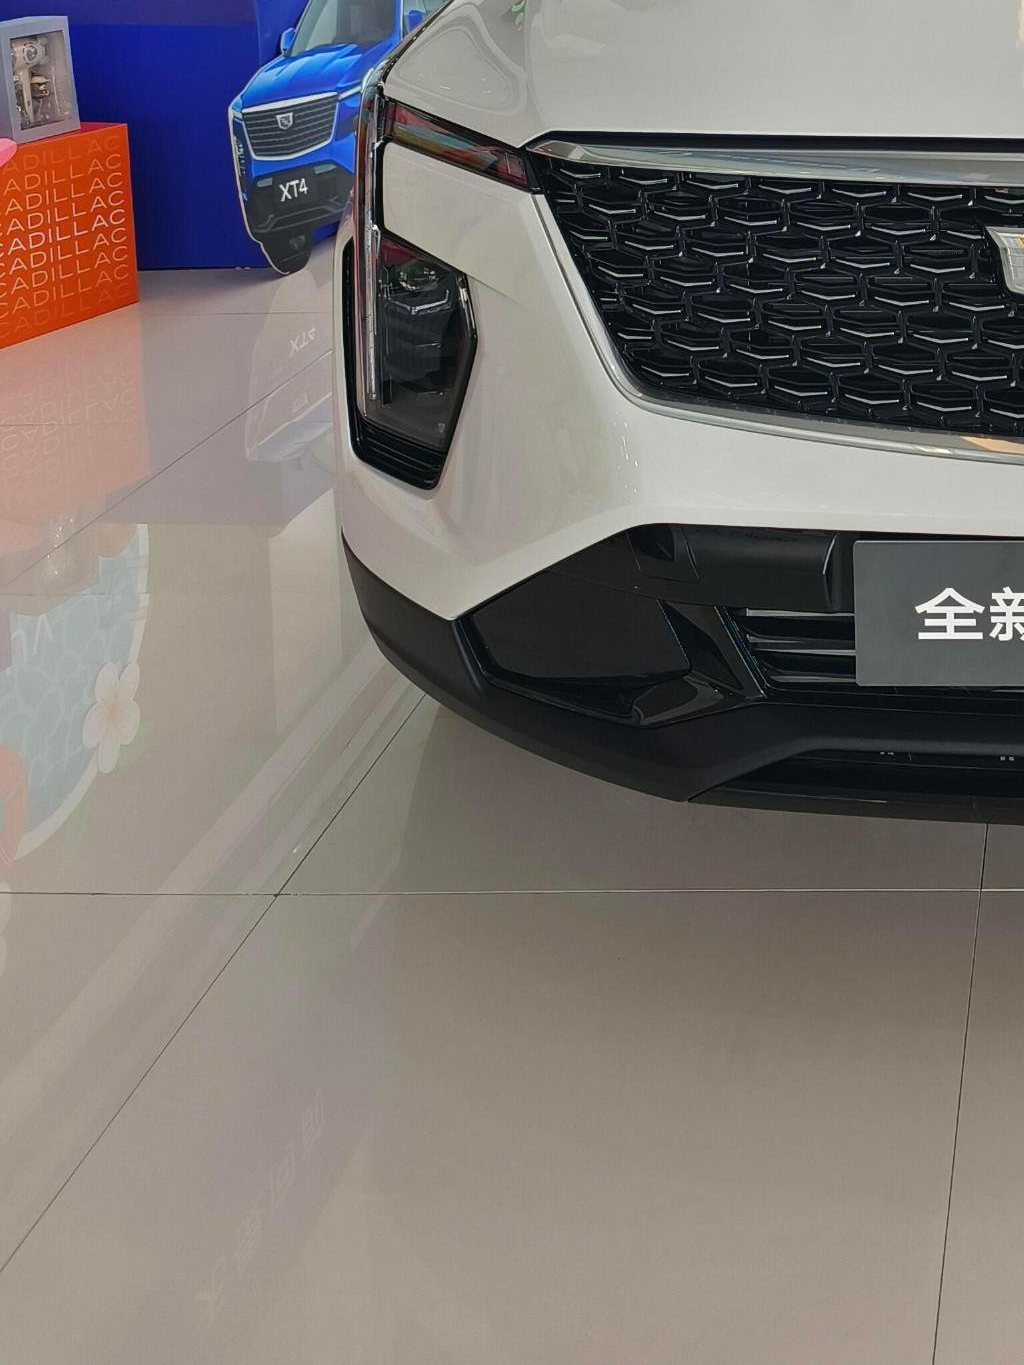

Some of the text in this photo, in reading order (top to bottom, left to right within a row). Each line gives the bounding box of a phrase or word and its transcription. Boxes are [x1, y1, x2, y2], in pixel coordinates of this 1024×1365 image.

[2, 135, 121, 175] ADILLAC
[3, 153, 121, 196] ADILLAC
[4, 172, 123, 216] ADILLAC
[279, 178, 308, 202] XT4
[0, 190, 125, 236] ADILLAC
[0, 209, 126, 258] ADILLAC
